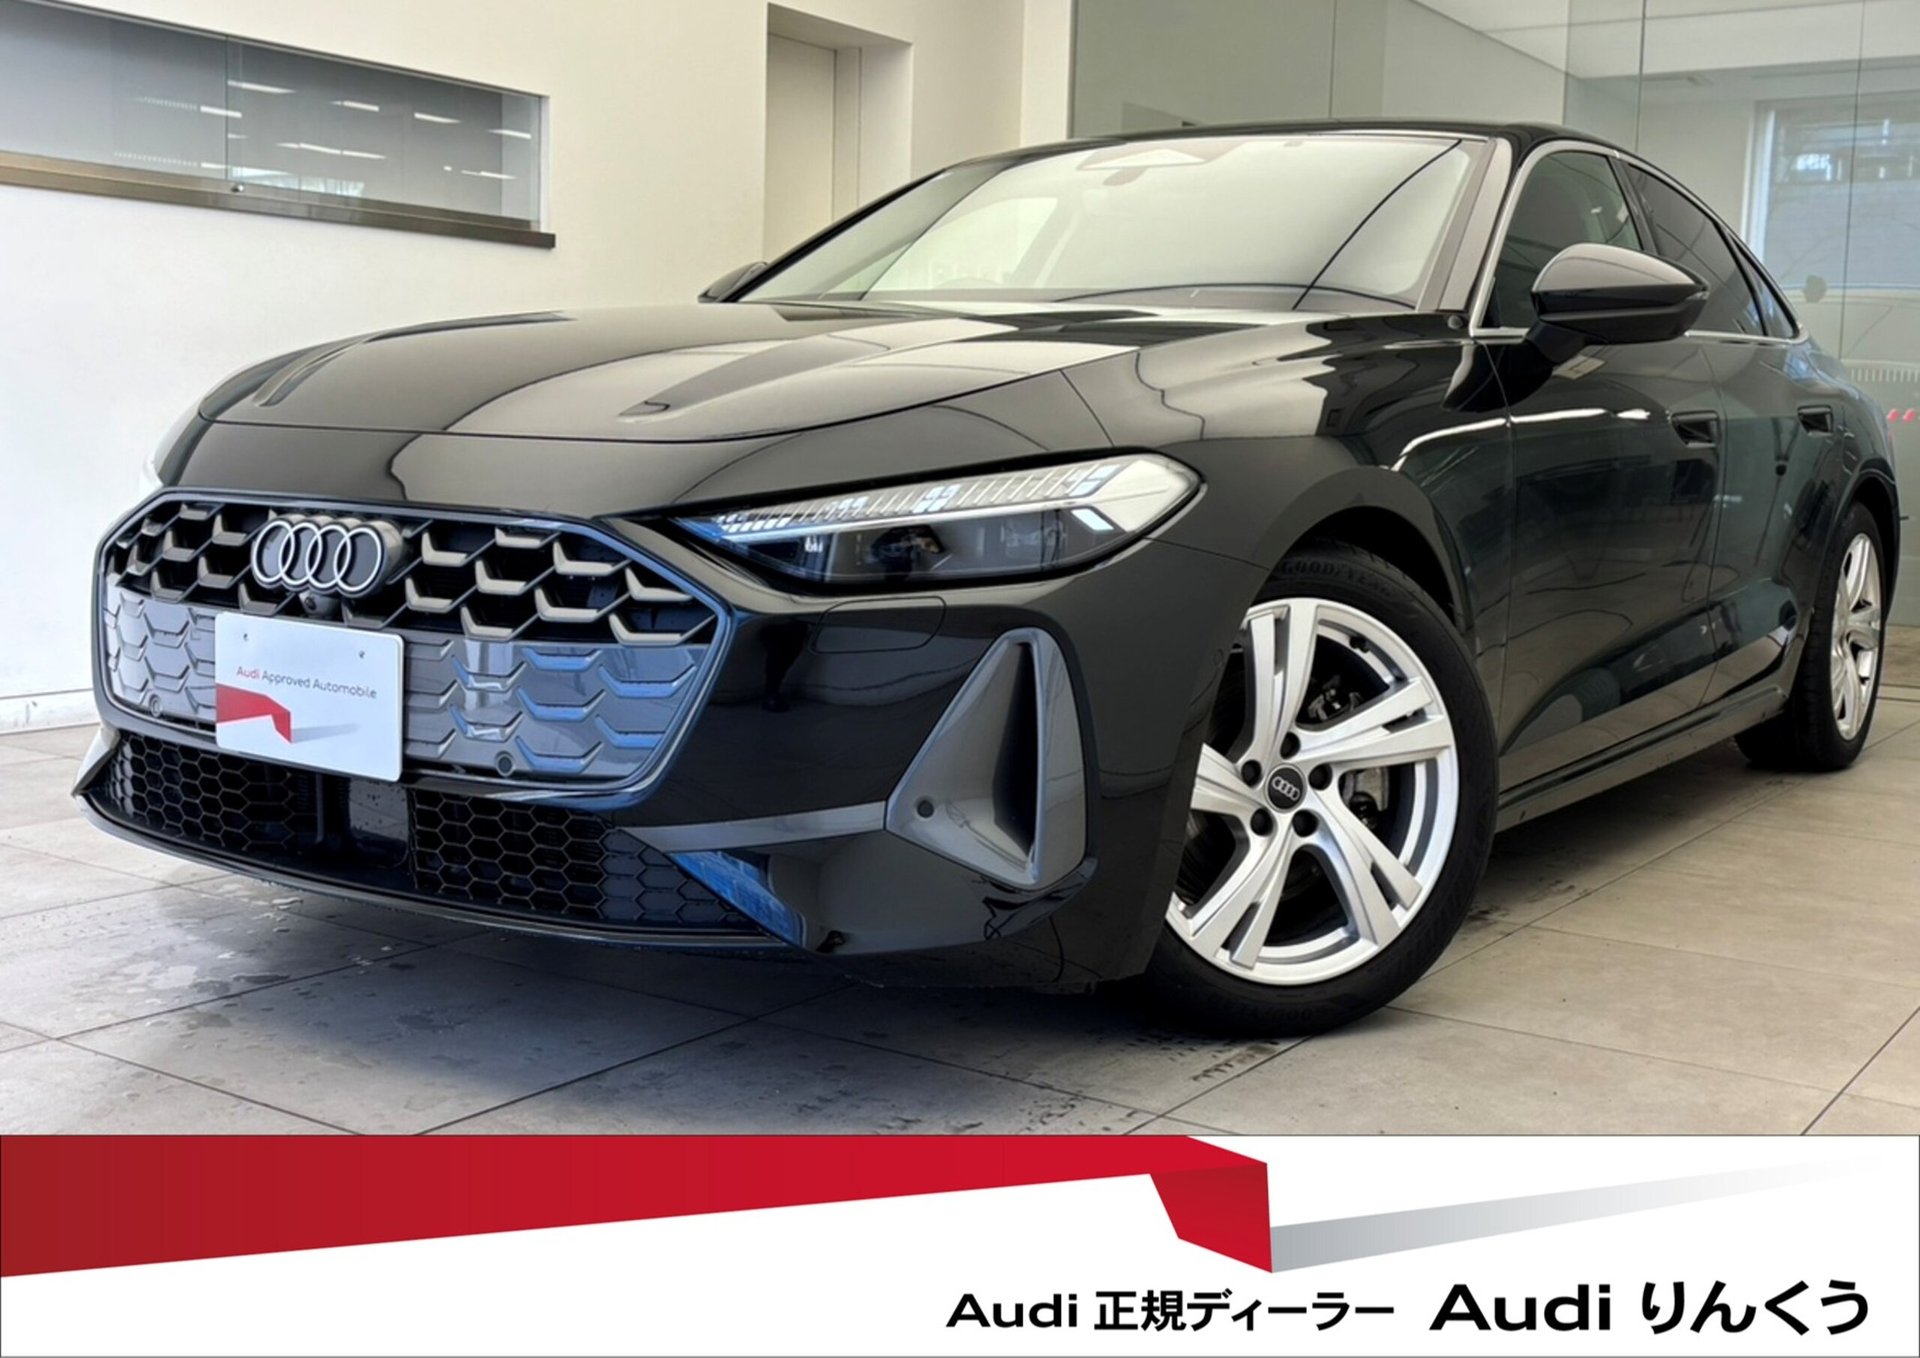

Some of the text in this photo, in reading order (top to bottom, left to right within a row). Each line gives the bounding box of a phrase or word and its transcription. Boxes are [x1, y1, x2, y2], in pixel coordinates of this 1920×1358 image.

[236, 665, 377, 699] Audi Approved Automobile
